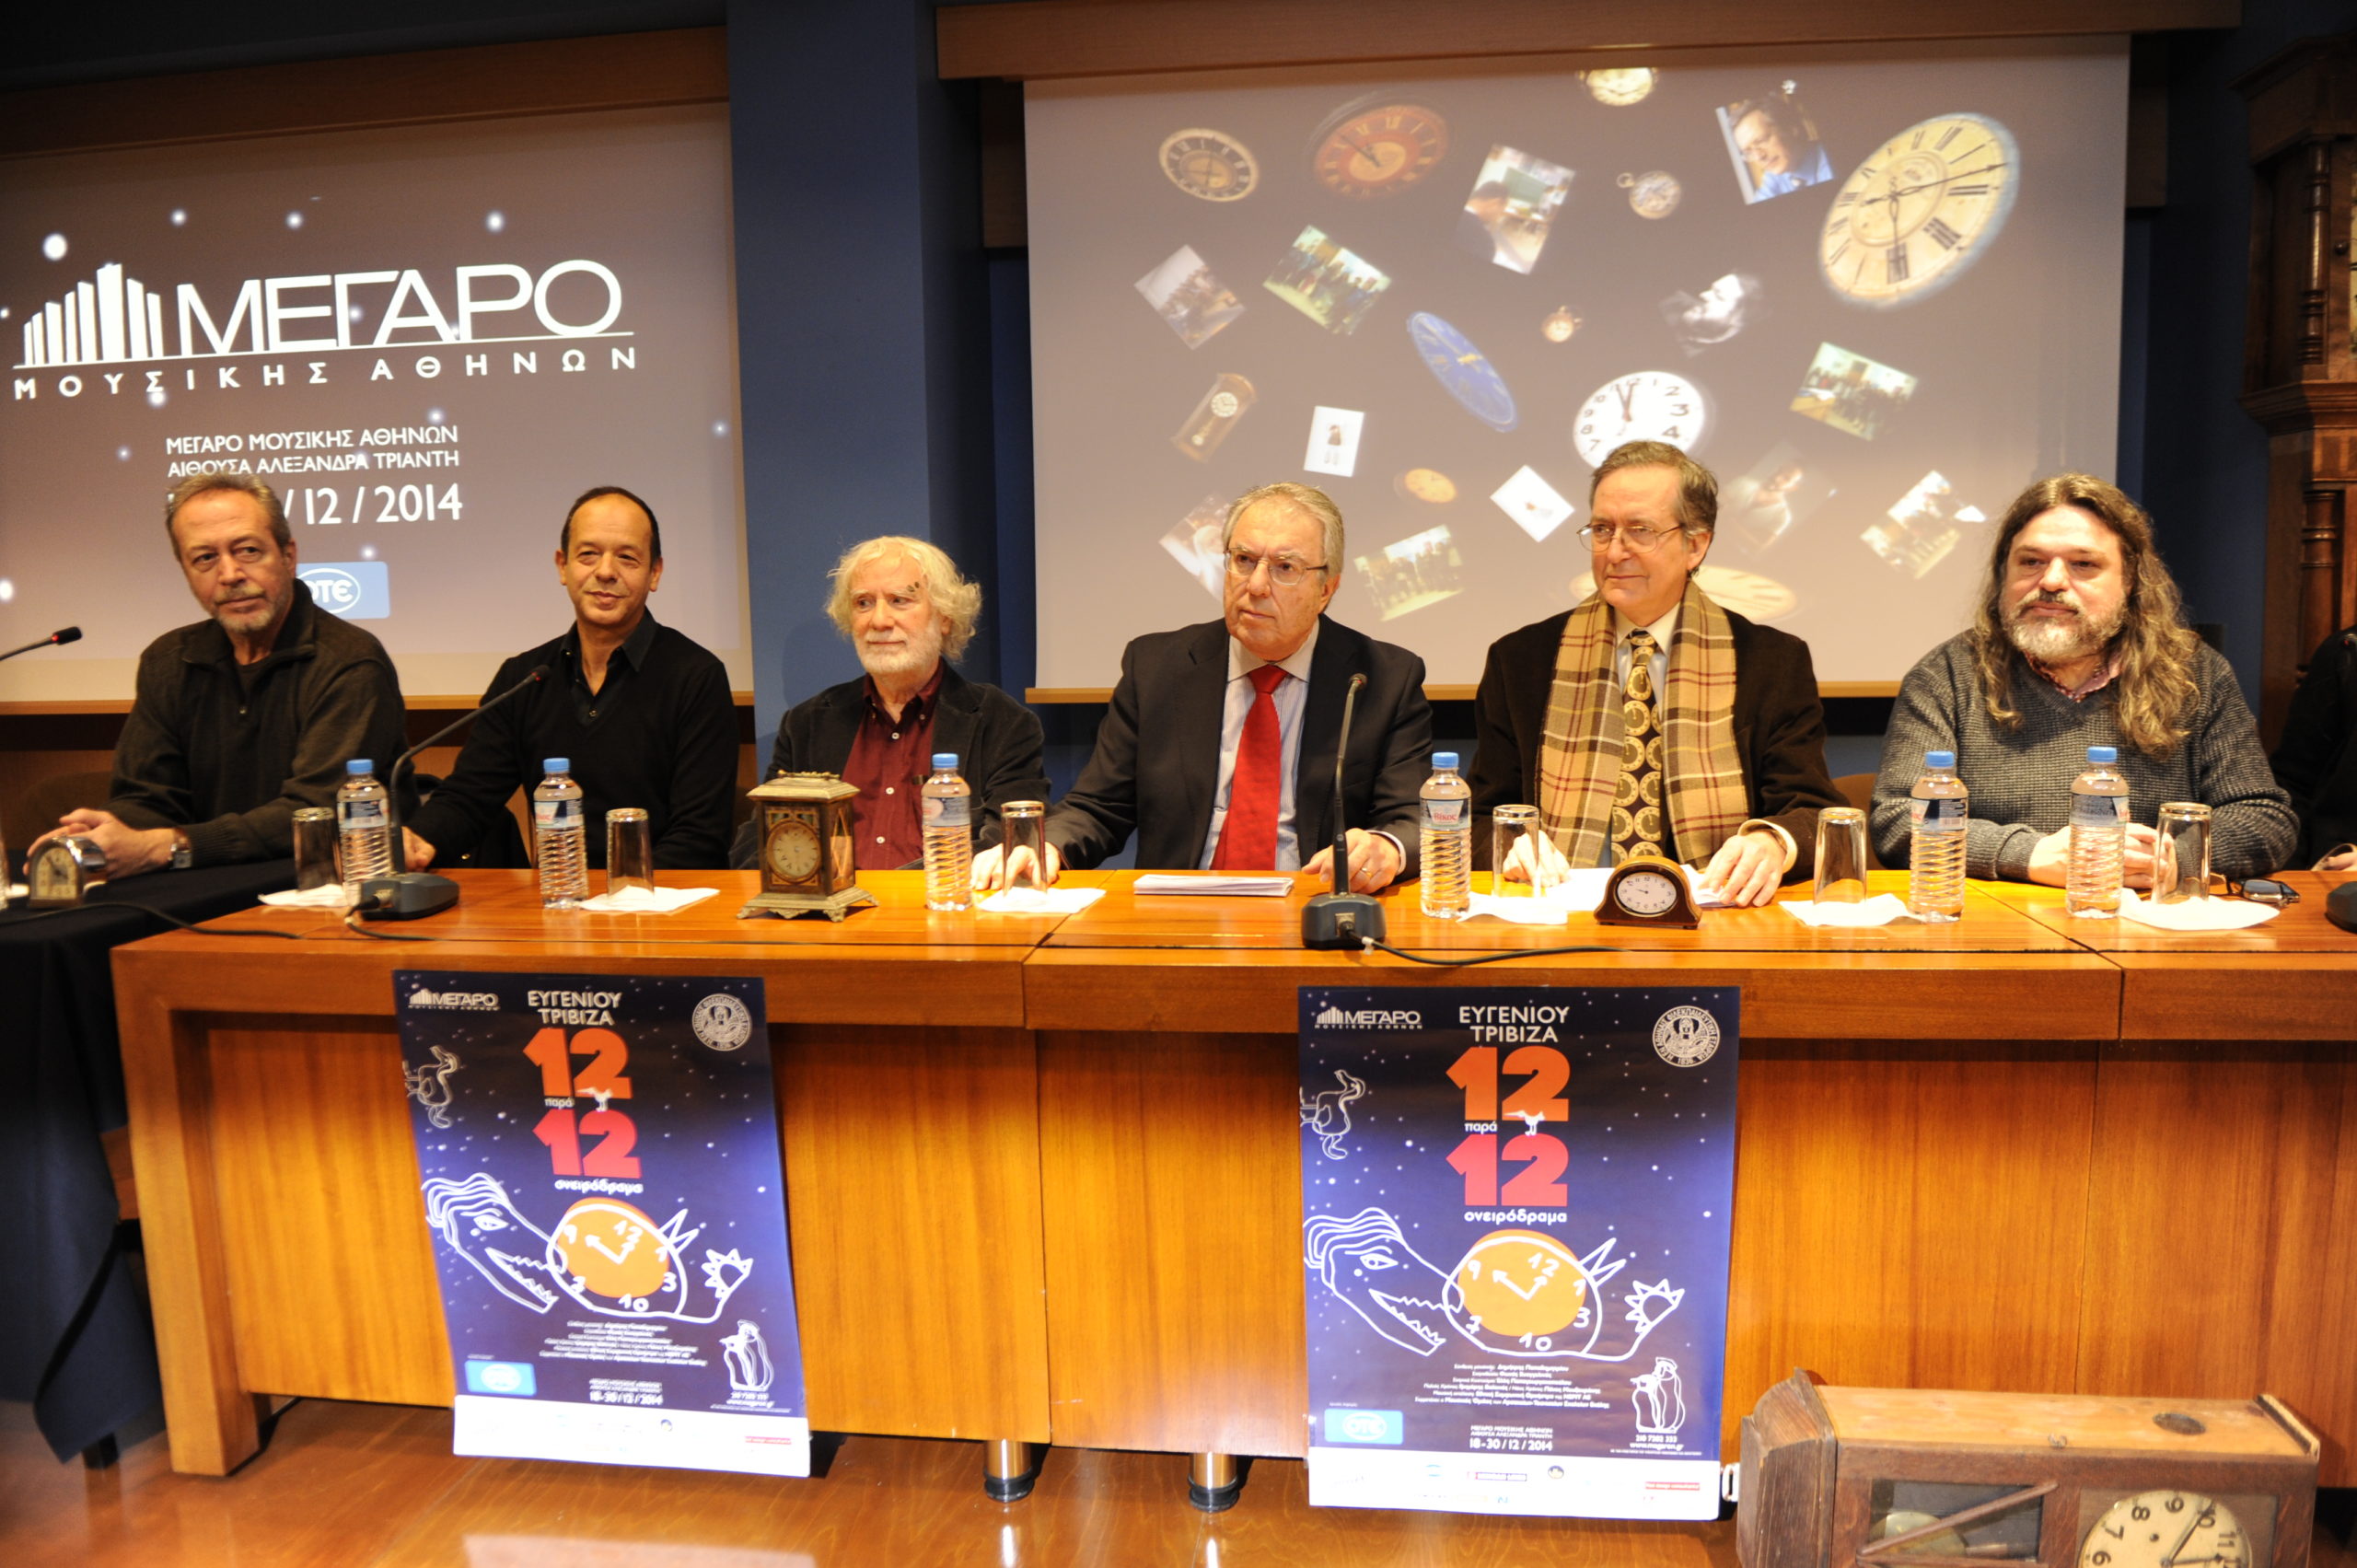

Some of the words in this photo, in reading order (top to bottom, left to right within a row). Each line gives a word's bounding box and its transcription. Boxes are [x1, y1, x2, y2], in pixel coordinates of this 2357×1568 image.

[178, 259, 623, 356] ΜΕΓΑΡΟ
[14, 362, 328, 401] ΜΟΥΣΙΚΗΣ
[371, 347, 636, 382] ΑΘΗΝΩΝ
[1670, 403, 1689, 416] 3
[166, 435, 243, 455] ΜΕΓΑΡΟ
[249, 429, 354, 451] ΜΟΥΣΙΚΗΣ
[359, 425, 459, 447] ΑΘΗΝΩΝ
[1661, 425, 1680, 439] 4
[168, 459, 252, 477] ΑΙΘΟΥΣΑ
[257, 454, 369, 474] ΑΛΕΞΑΝΔΡΑ
[373, 450, 460, 470] ΤΡΙΑΝΤΗ
[306, 487, 342, 525] 12
[374, 482, 463, 523] 2014
[432, 993, 499, 1006] ΜΕΓΑΡΟ
[527, 990, 622, 1008] ΕΥΓΕΝΙΟΥ
[537, 1007, 616, 1026] ΤΡΙΒΙΖΑ
[1344, 1011, 1421, 1024] ΜΕΓΑΡΟ
[1458, 1006, 1570, 1024] ΕΥΓΕΝΙΟΥ
[1469, 1026, 1559, 1042] ΤΡΙΒΙΖΑ
[522, 1028, 633, 1098] 12
[1446, 1046, 1570, 1121] 12
[544, 1097, 575, 1110] παρά
[1464, 1121, 1497, 1134] παρά
[532, 1109, 643, 1179] 12
[1446, 1132, 1569, 1206] 12
[554, 1179, 644, 1196] ονειρόδραμα
[1464, 1208, 1567, 1225] ονειρόδραμα
[1527, 1252, 1560, 1277] 12
[661, 1272, 677, 1292] 3
[618, 1294, 649, 1312] 10
[1573, 1307, 1591, 1329] 3
[1518, 1332, 1552, 1352] 10
[1469, 1437, 1501, 1449] 18-30
[1508, 1438, 1519, 1450] 12
[1527, 1439, 1553, 1451] 2014
[2131, 1505, 2151, 1521] 8
